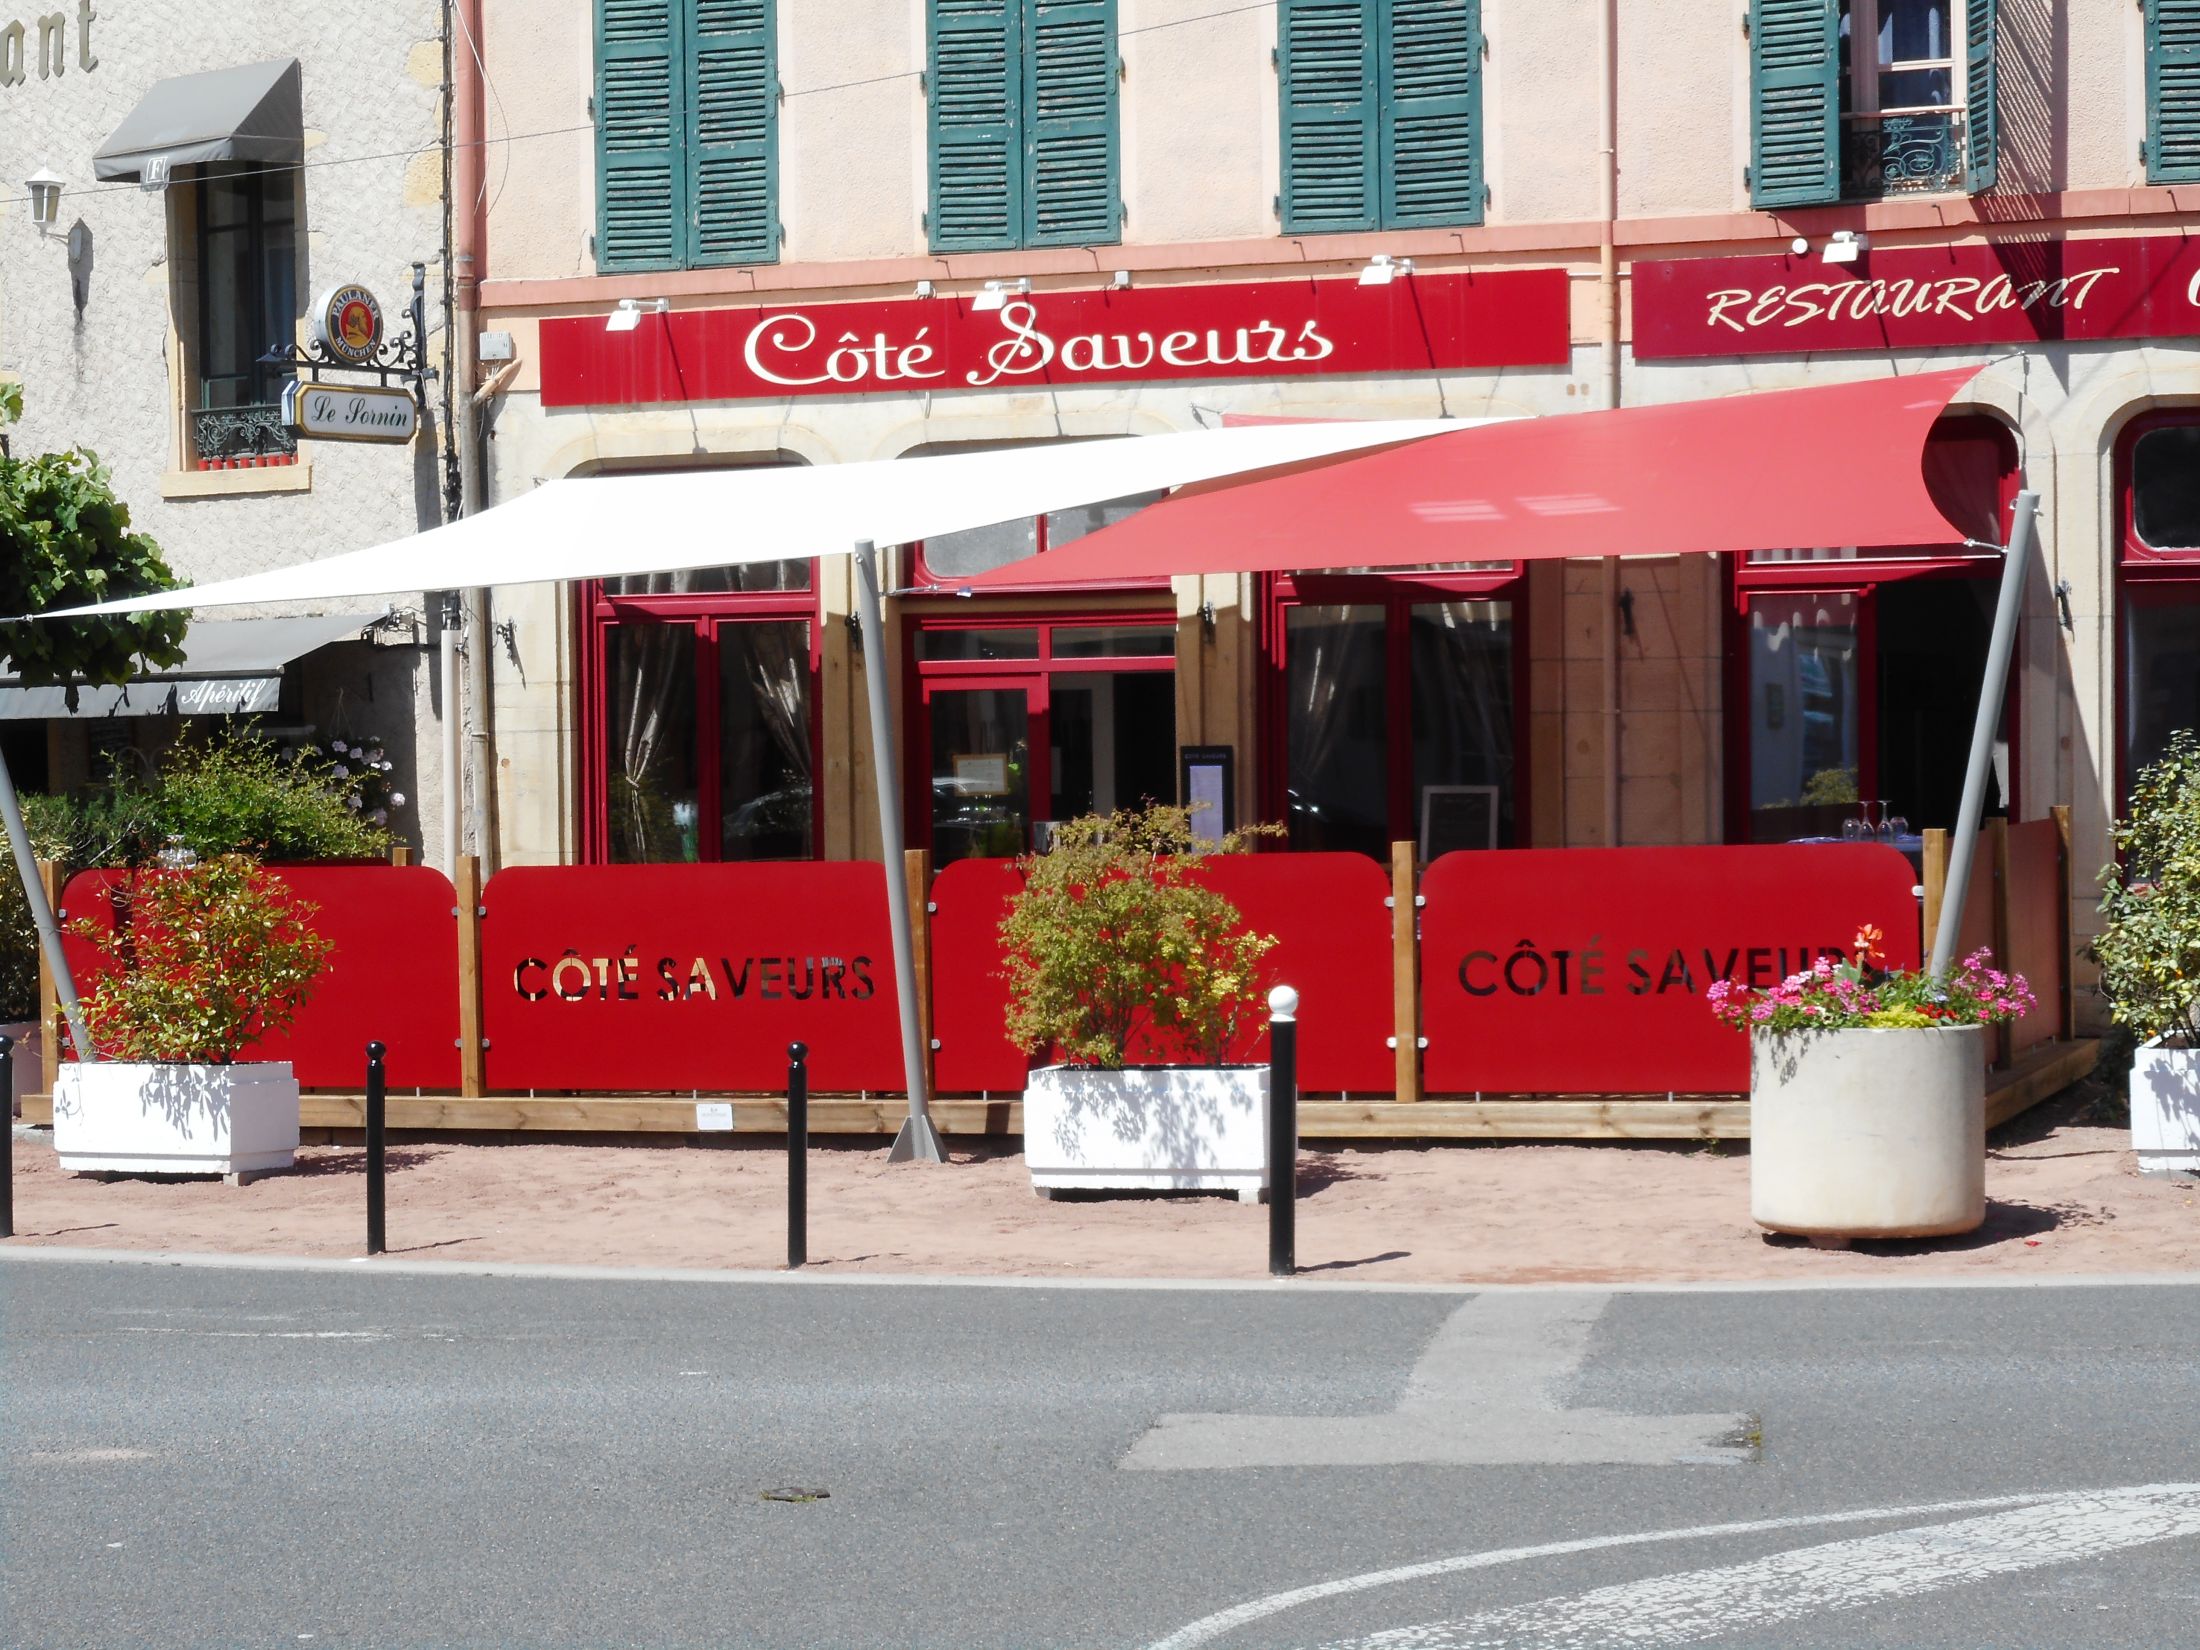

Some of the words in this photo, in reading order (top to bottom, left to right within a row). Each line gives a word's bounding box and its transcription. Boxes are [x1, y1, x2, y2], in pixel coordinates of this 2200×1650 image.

[332, 290, 379, 319] PAULANER
[744, 313, 945, 386] Côté
[966, 301, 1334, 386] Saveurs
[311, 395, 336, 423] Le
[345, 397, 408, 427] Sornin
[181, 679, 266, 712] Apéritif
[513, 944, 639, 1002] CÔTÉ
[656, 956, 875, 1002] SAVEURS
[1458, 935, 1605, 997] CÔTÉ
